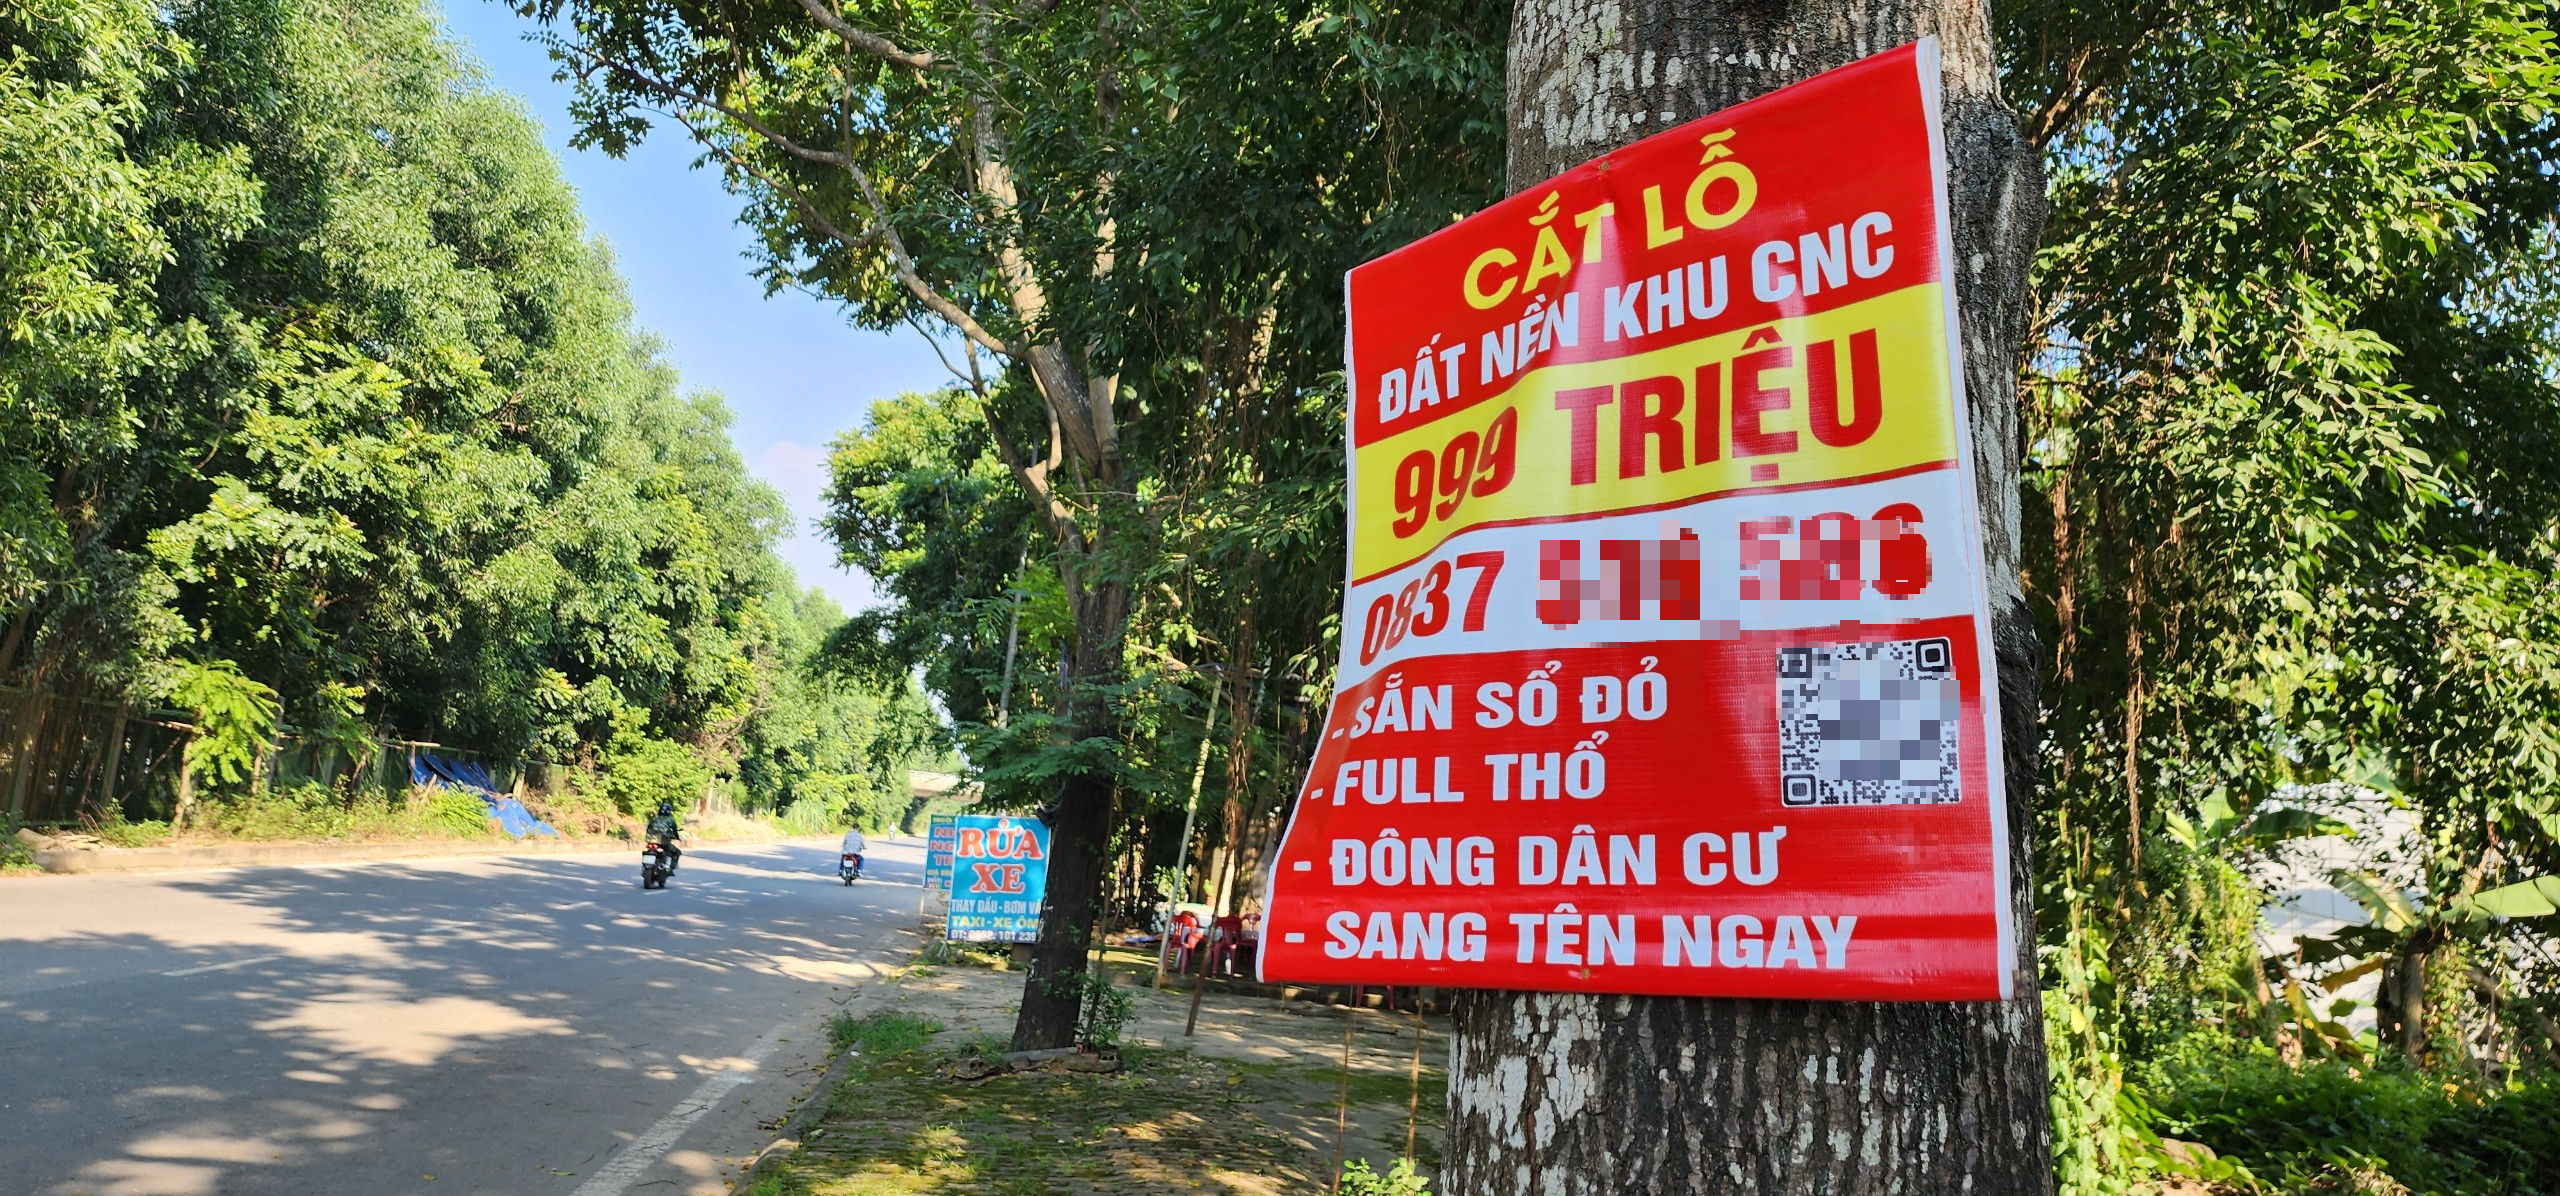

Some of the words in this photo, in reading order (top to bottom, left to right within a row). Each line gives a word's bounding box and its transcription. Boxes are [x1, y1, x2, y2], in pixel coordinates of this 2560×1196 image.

[1463, 190, 1615, 310] CẮT
[1642, 128, 1758, 251] LỖ
[1378, 332, 1466, 424] ĐẤT
[1481, 294, 1579, 386] NỀN
[1603, 254, 1729, 342] KHU
[1751, 211, 1895, 303] CNC
[1392, 405, 1518, 540] 999
[1554, 326, 1883, 486] TRIỆU
[1359, 551, 1505, 667] 0837
[1349, 672, 1453, 739] SẴN
[1475, 660, 1562, 728] SỔ
[1579, 655, 1668, 724] ĐỎ
[1332, 756, 1465, 806] FULL
[1484, 730, 1610, 801] THỔ
[957, 817, 1044, 859] RỬA
[1329, 828, 1495, 887] ĐÔNG
[1517, 824, 1657, 886] DÂN
[1682, 825, 1788, 887] CƯ
[951, 898, 976, 912] THAY
[970, 862, 1026, 893] XE
[951, 916, 985, 927] TAXI
[993, 917, 1012, 928] XE
[1323, 909, 1488, 962] SANG
[1509, 902, 1636, 967] TÊN
[1661, 914, 1858, 969] NGAY
